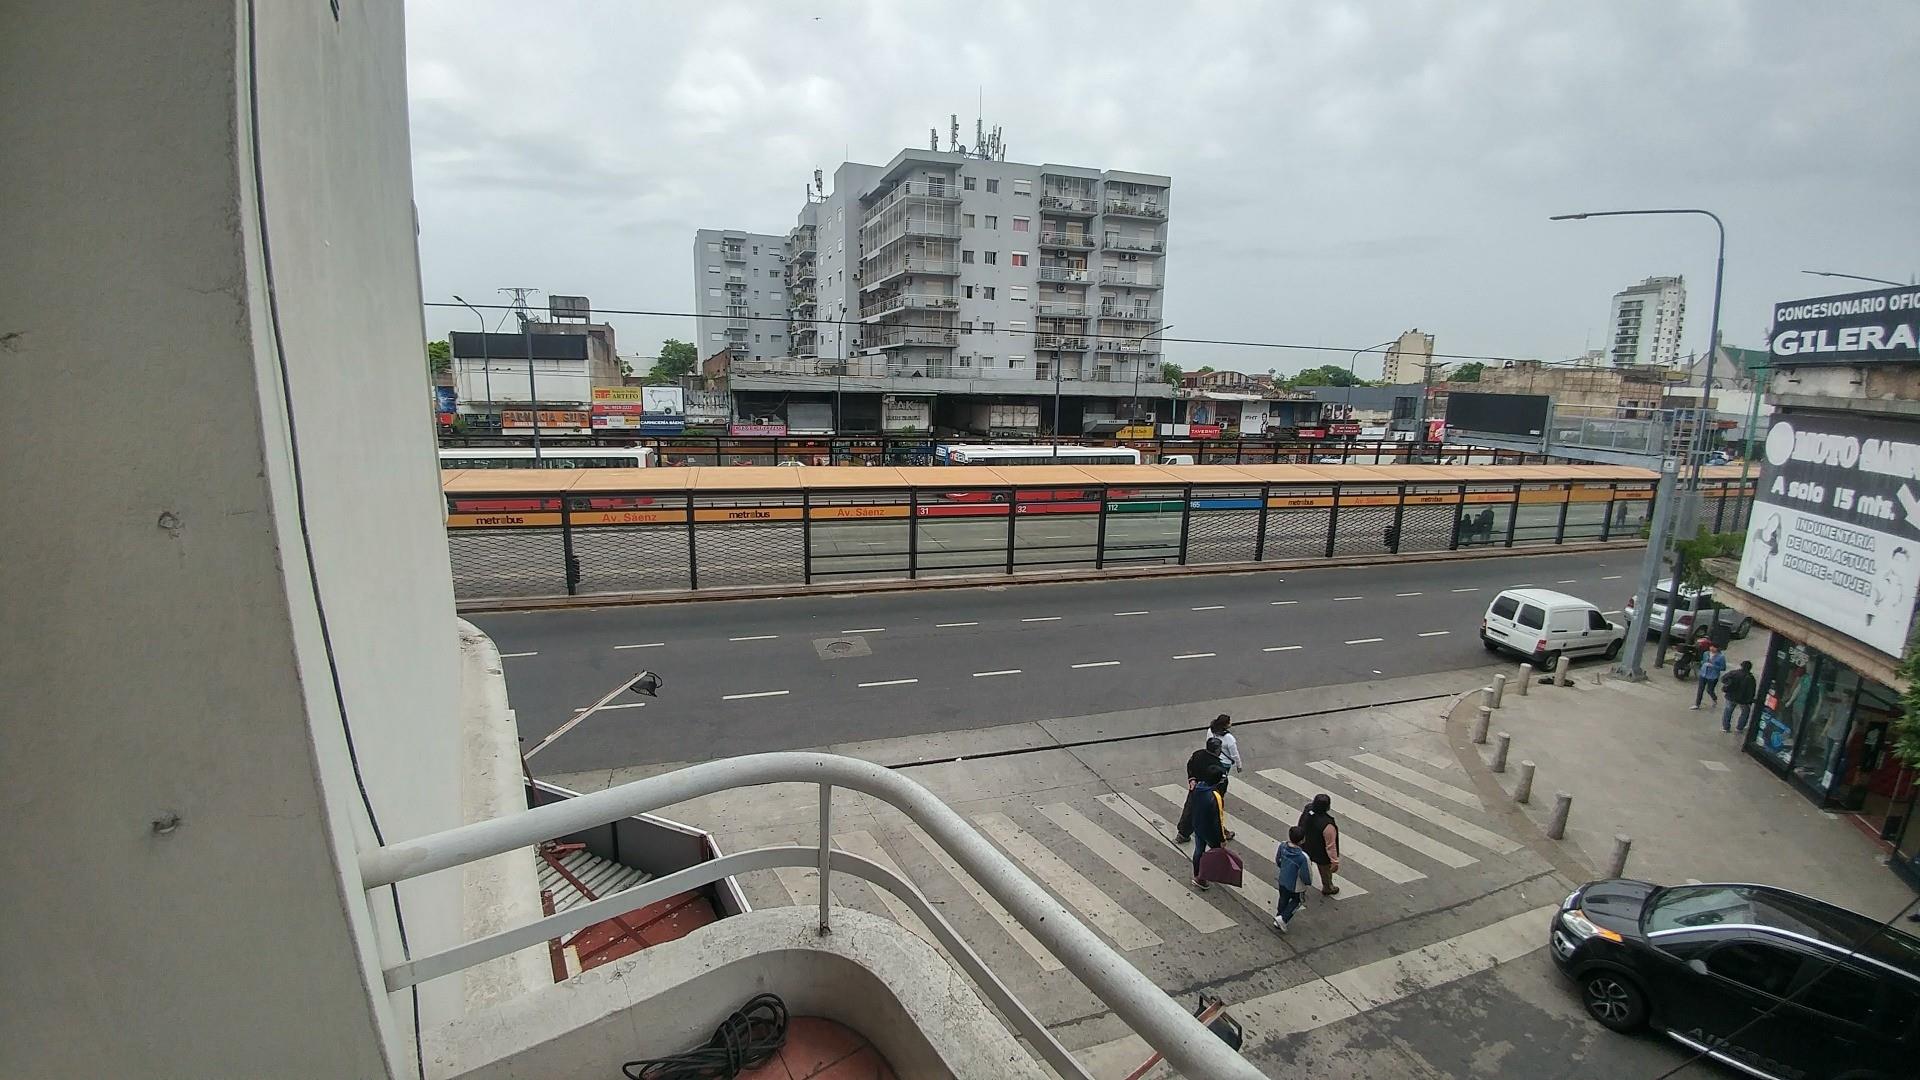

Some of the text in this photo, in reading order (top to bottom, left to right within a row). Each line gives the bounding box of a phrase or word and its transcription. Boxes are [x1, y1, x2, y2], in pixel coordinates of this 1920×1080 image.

[1777, 297, 1886, 321] CONCESIONARIO
[1773, 324, 1917, 356] GILERA
[1771, 476, 1785, 495] A
[1788, 481, 1825, 503] solo
[1833, 487, 1856, 510] 15
[1018, 505, 1027, 513] 32
[1190, 501, 1201, 509] 165
[728, 510, 770, 519] metrobus
[837, 508, 852, 517] Av.
[920, 507, 929, 515] 31
[476, 515, 524, 525] metrobus
[602, 513, 621, 522] Av.
[1795, 517, 1875, 552] INDUMENTARIA
[1786, 535, 1877, 574] DE MODA ACTUAL
[1783, 553, 1827, 581] HOMBRE
[1832, 570, 1872, 597] MUJER
